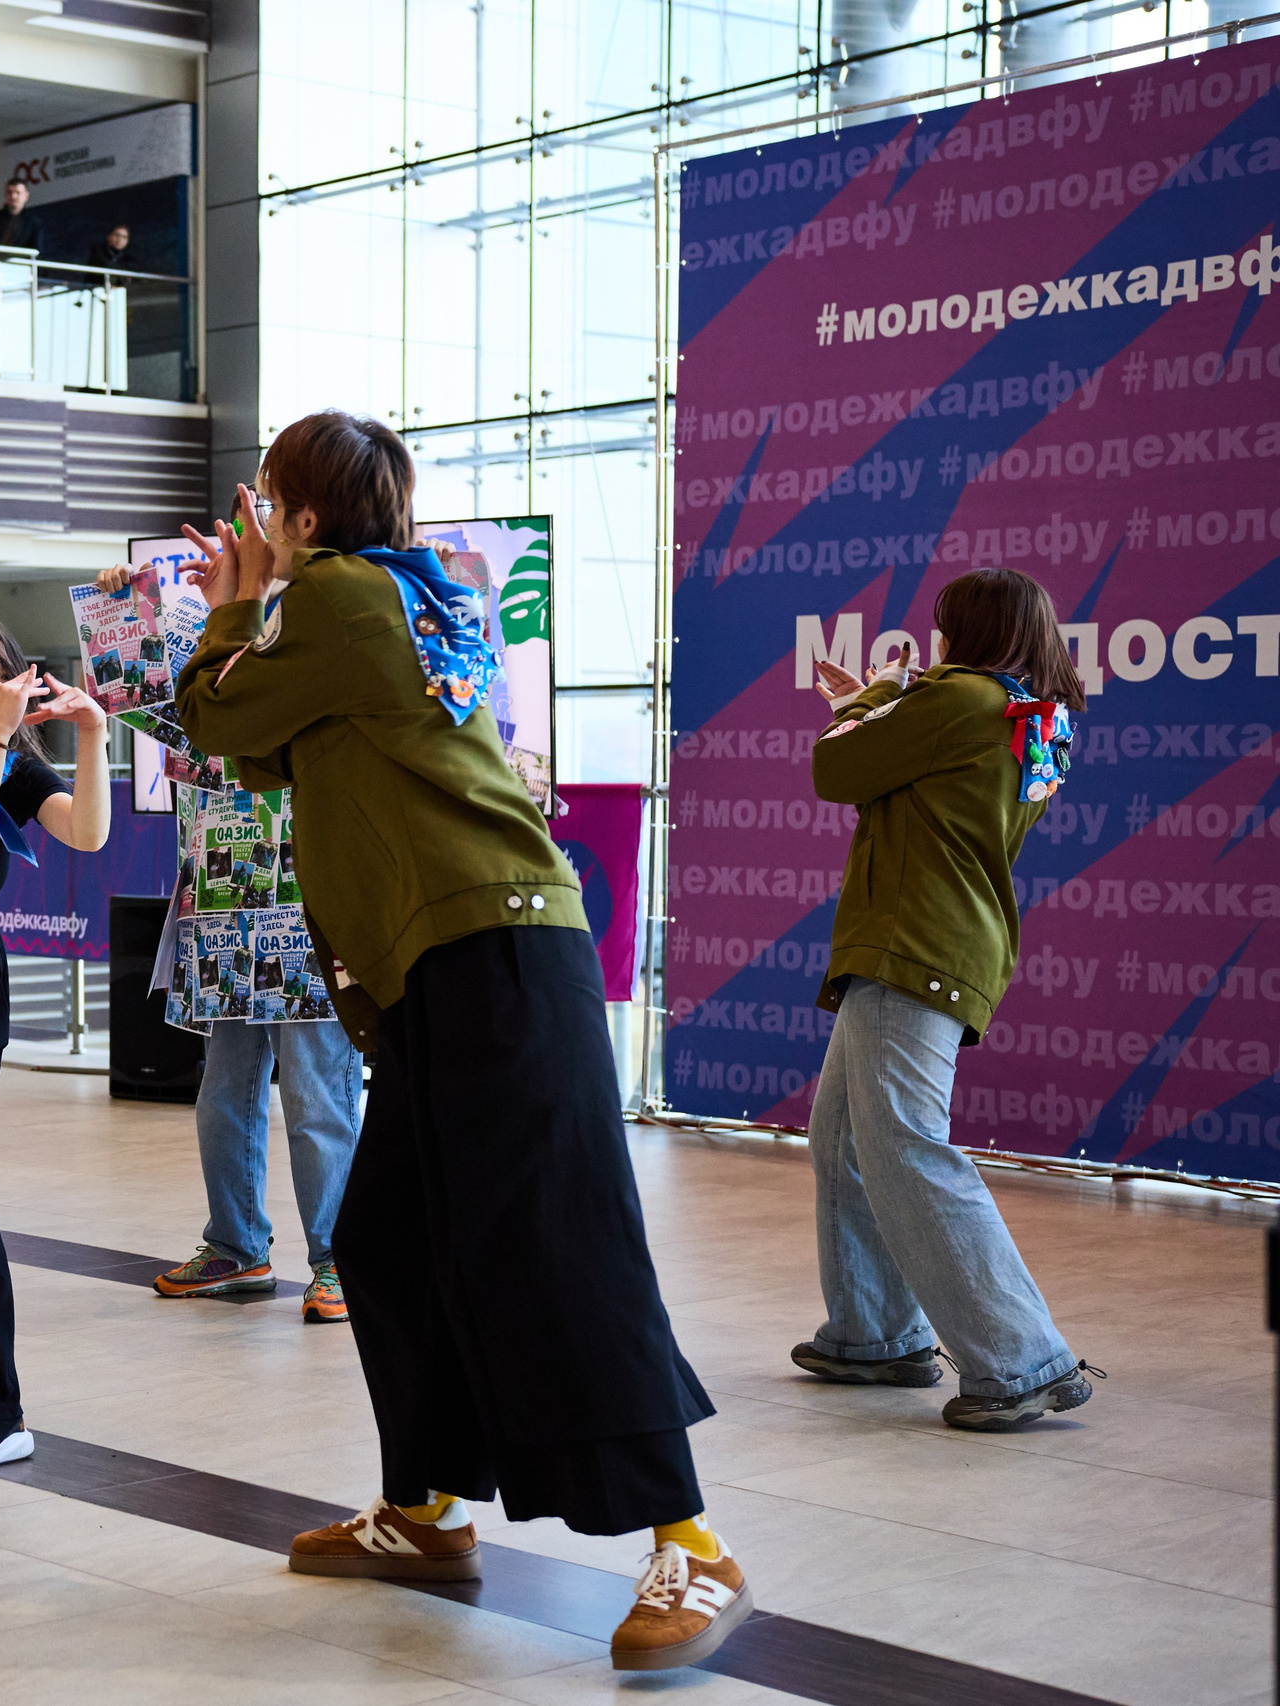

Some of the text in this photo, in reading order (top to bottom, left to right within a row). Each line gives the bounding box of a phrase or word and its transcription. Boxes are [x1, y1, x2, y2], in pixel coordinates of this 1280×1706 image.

[681, 62, 1280, 209] #молодежкадвфу #мол
[678, 361, 1104, 443] #молодежкадвфу
[680, 512, 1108, 579] #молодежкадвфу
[81, 600, 133, 622] СТУДЕНЧЕСТВО
[99, 615, 120, 627] ЗДЕСЬ
[100, 621, 147, 646] ОАЗИС
[220, 812, 239, 822] ЗДЕСЬ
[217, 825, 261, 841] ОАЗИС
[206, 920, 222, 930] ЗДЕСЬ
[261, 922, 285, 931] ЗДЕСЬ
[206, 932, 241, 949] ОАЗИС
[260, 934, 314, 951] ОАЗИС
